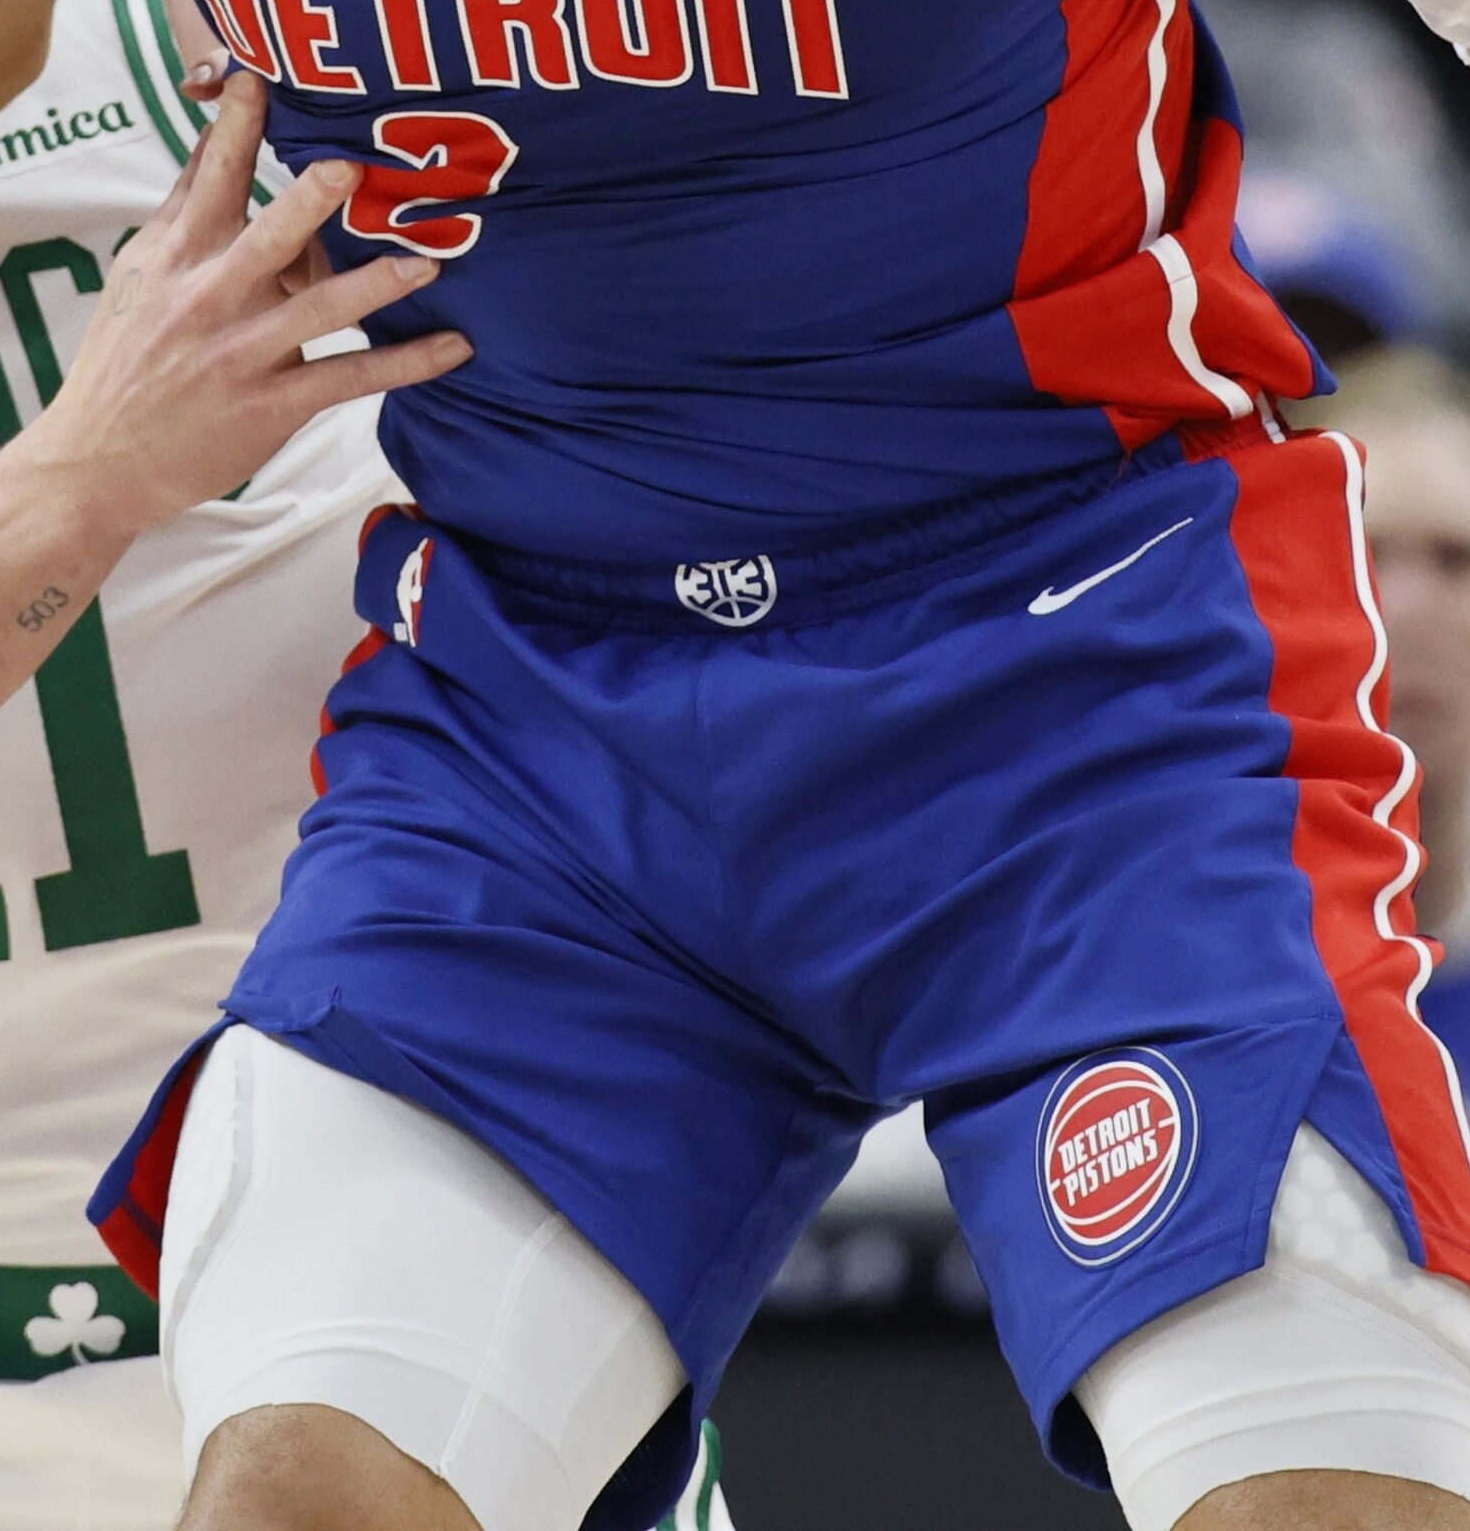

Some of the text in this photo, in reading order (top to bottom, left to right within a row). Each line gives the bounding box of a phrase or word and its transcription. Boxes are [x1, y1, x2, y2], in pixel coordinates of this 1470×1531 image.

[341, 111, 519, 259] 2
[17, 586, 70, 633] 503
[1058, 1098, 1150, 1173] DETROIT
[1063, 1129, 1158, 1206] PISTONS
